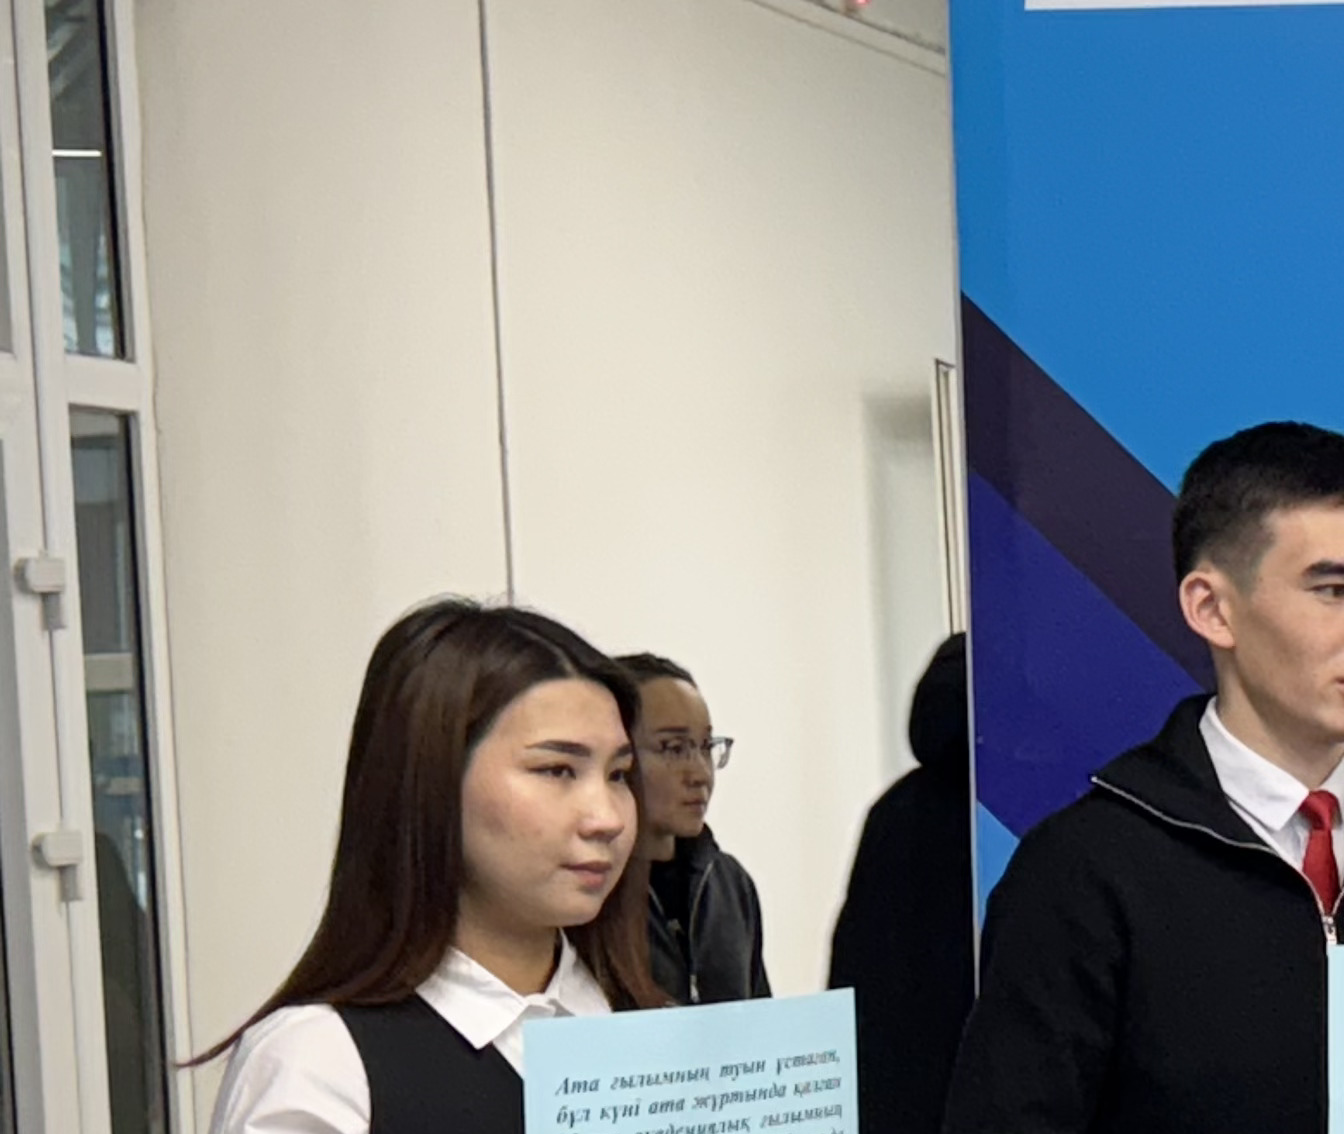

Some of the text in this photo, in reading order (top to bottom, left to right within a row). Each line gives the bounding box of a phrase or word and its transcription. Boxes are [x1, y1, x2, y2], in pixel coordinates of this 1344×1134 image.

[555, 1076, 601, 1097] Ата
[718, 1059, 767, 1082] туын
[648, 1098, 685, 1115] ата
